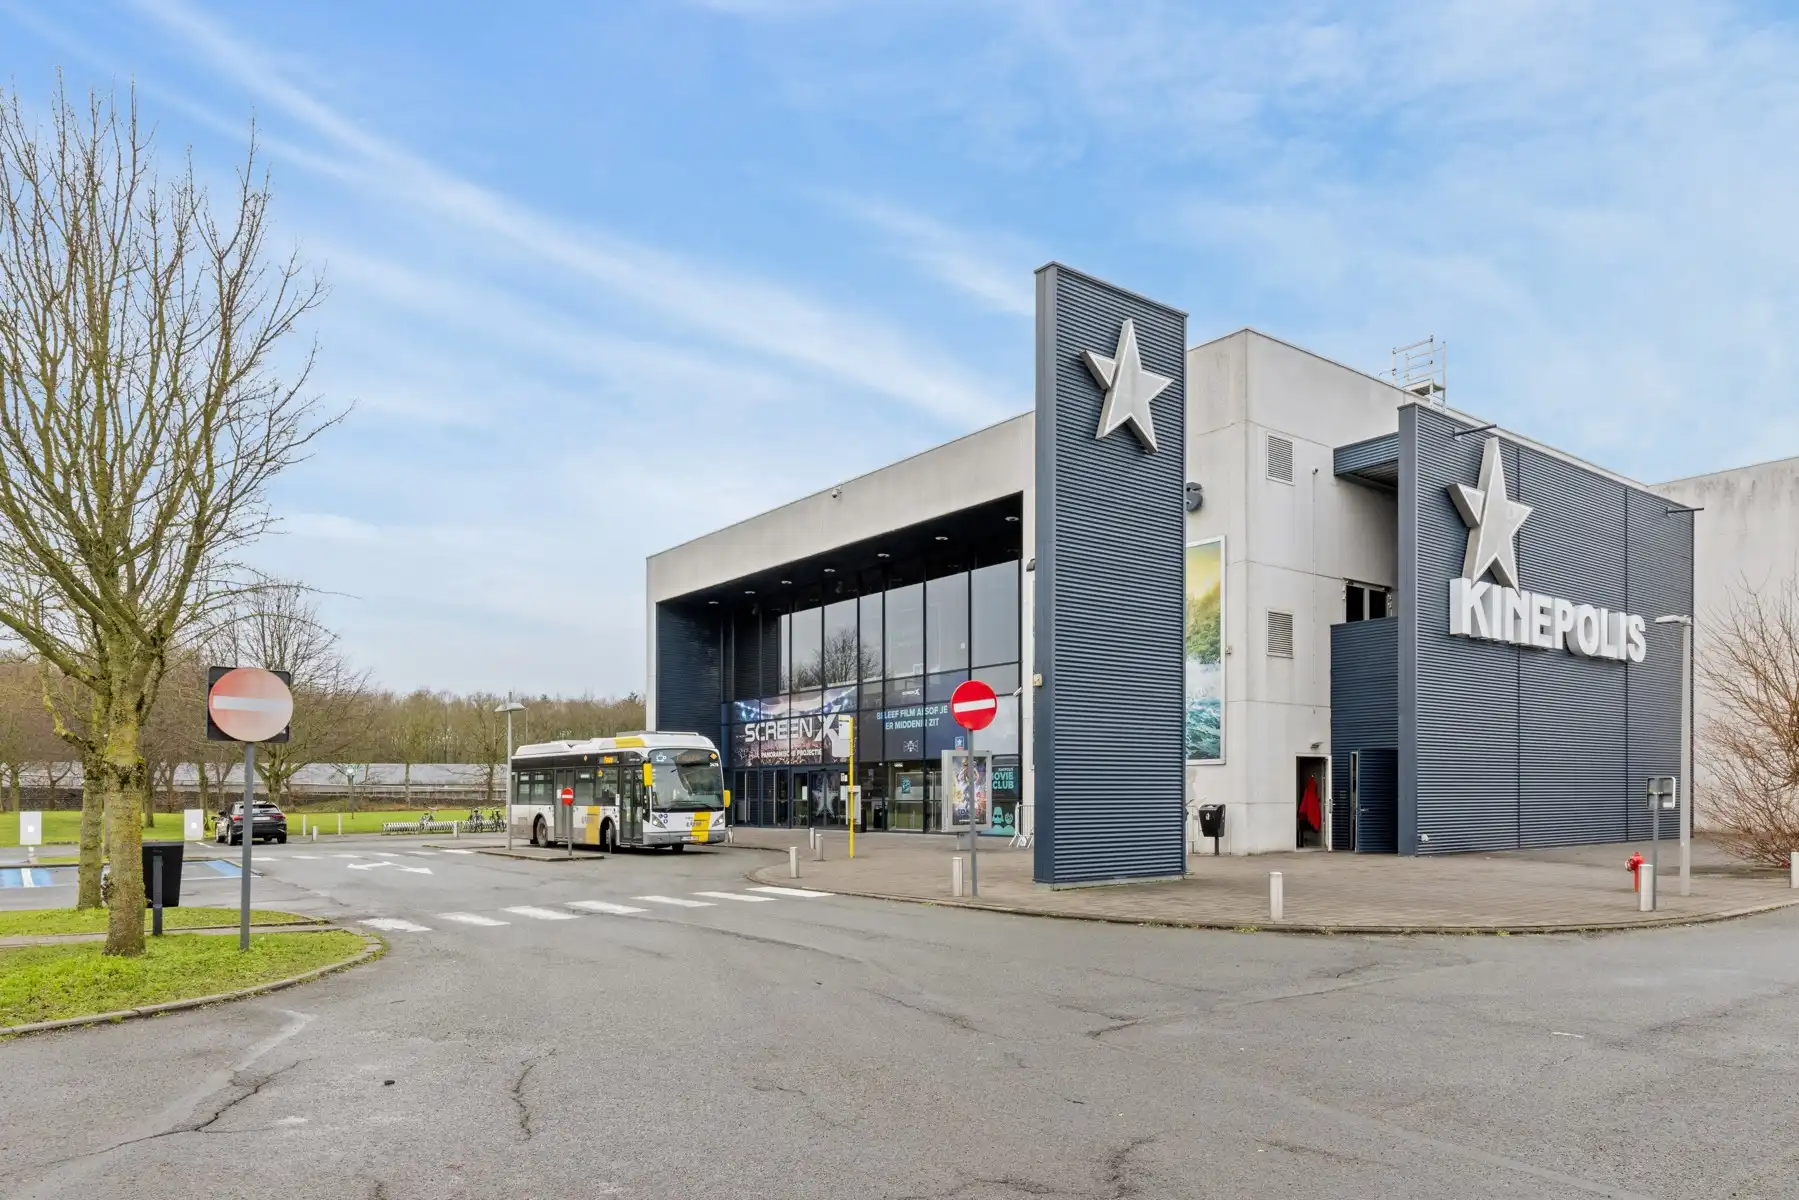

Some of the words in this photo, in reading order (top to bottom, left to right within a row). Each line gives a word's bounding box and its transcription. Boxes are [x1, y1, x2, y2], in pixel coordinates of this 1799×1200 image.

[1449, 577, 1647, 663] KINEPOLIS
[900, 707, 916, 718] FILM
[939, 705, 948, 714] JE
[885, 721, 894, 730] ER
[928, 717, 940, 727] ZIT
[991, 771, 1014, 781] OVIE
[992, 780, 1015, 790] CLUB
